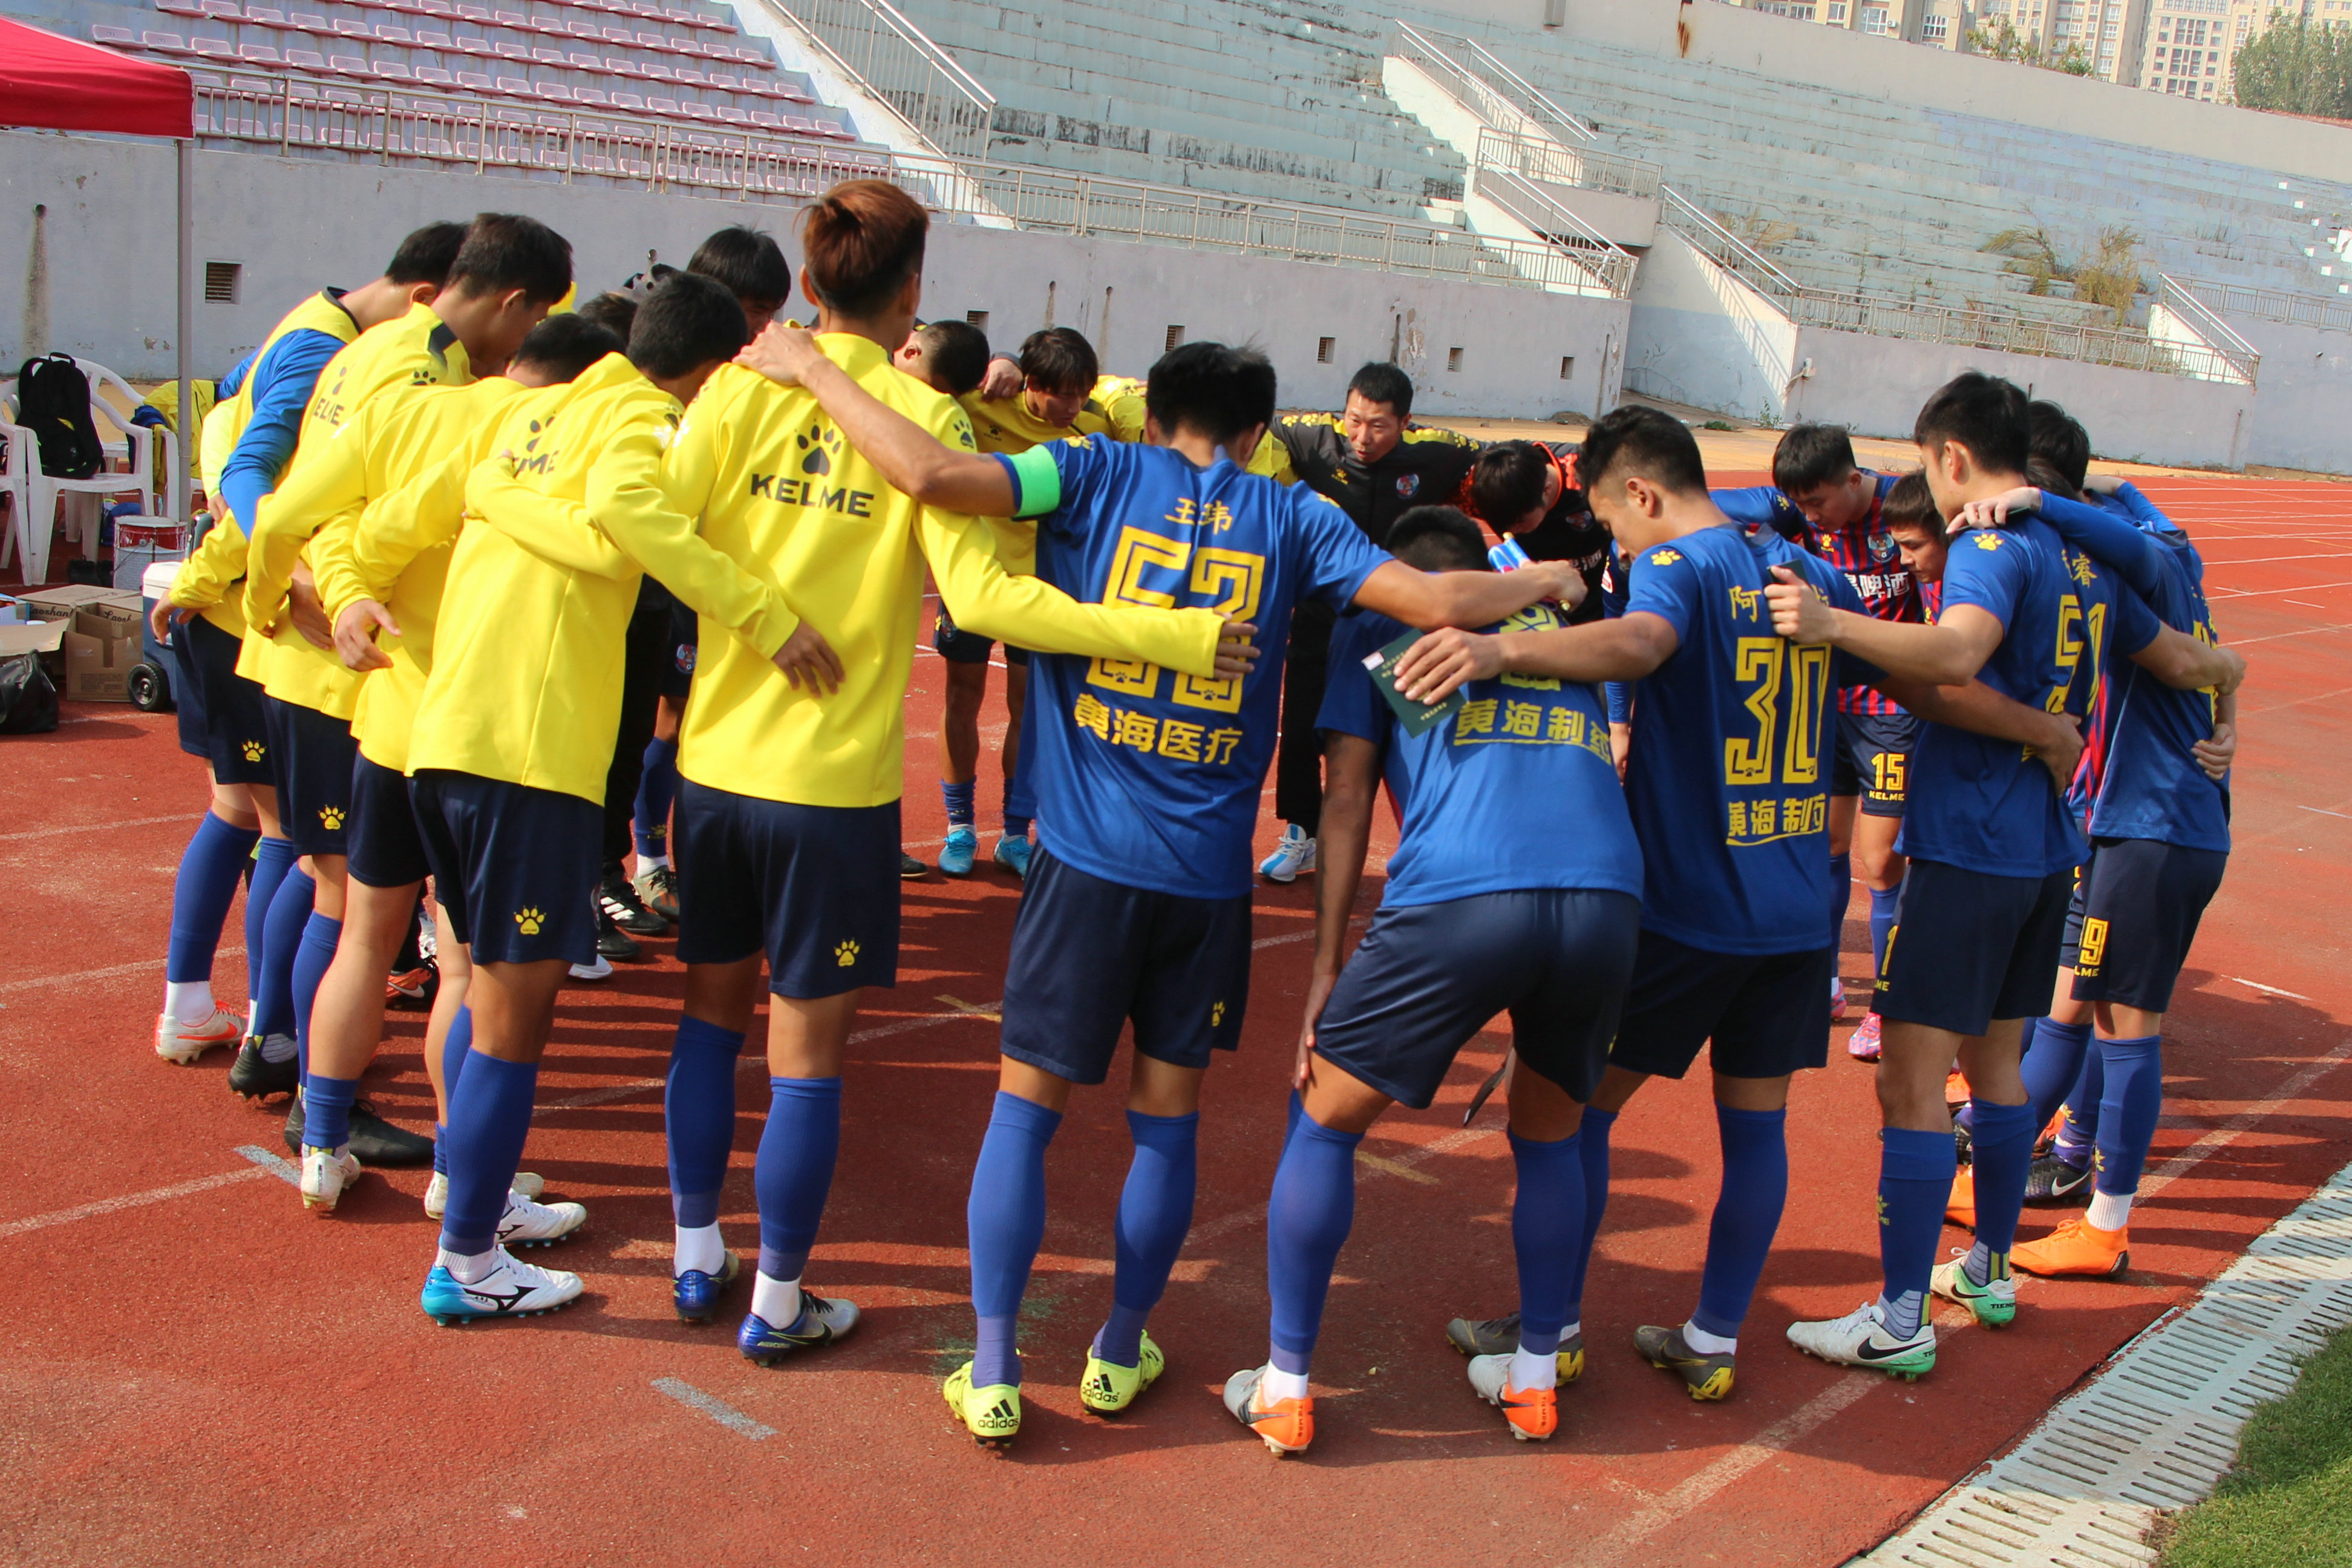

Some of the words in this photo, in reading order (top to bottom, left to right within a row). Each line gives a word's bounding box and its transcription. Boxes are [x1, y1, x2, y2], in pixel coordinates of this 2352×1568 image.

[750, 473, 874, 518] KELME
[1164, 497, 1233, 535] 王玮
[1074, 693, 1243, 765] 黄海医疗
[1725, 636, 1832, 785] 30
[1870, 753, 1905, 791] 15
[1869, 790, 1905, 802] KELME
[1881, 924, 1900, 976] 1
[2079, 915, 2110, 966] 9
[1082, 1386, 1119, 1403] adidas
[978, 1417, 1019, 1429] adidas
